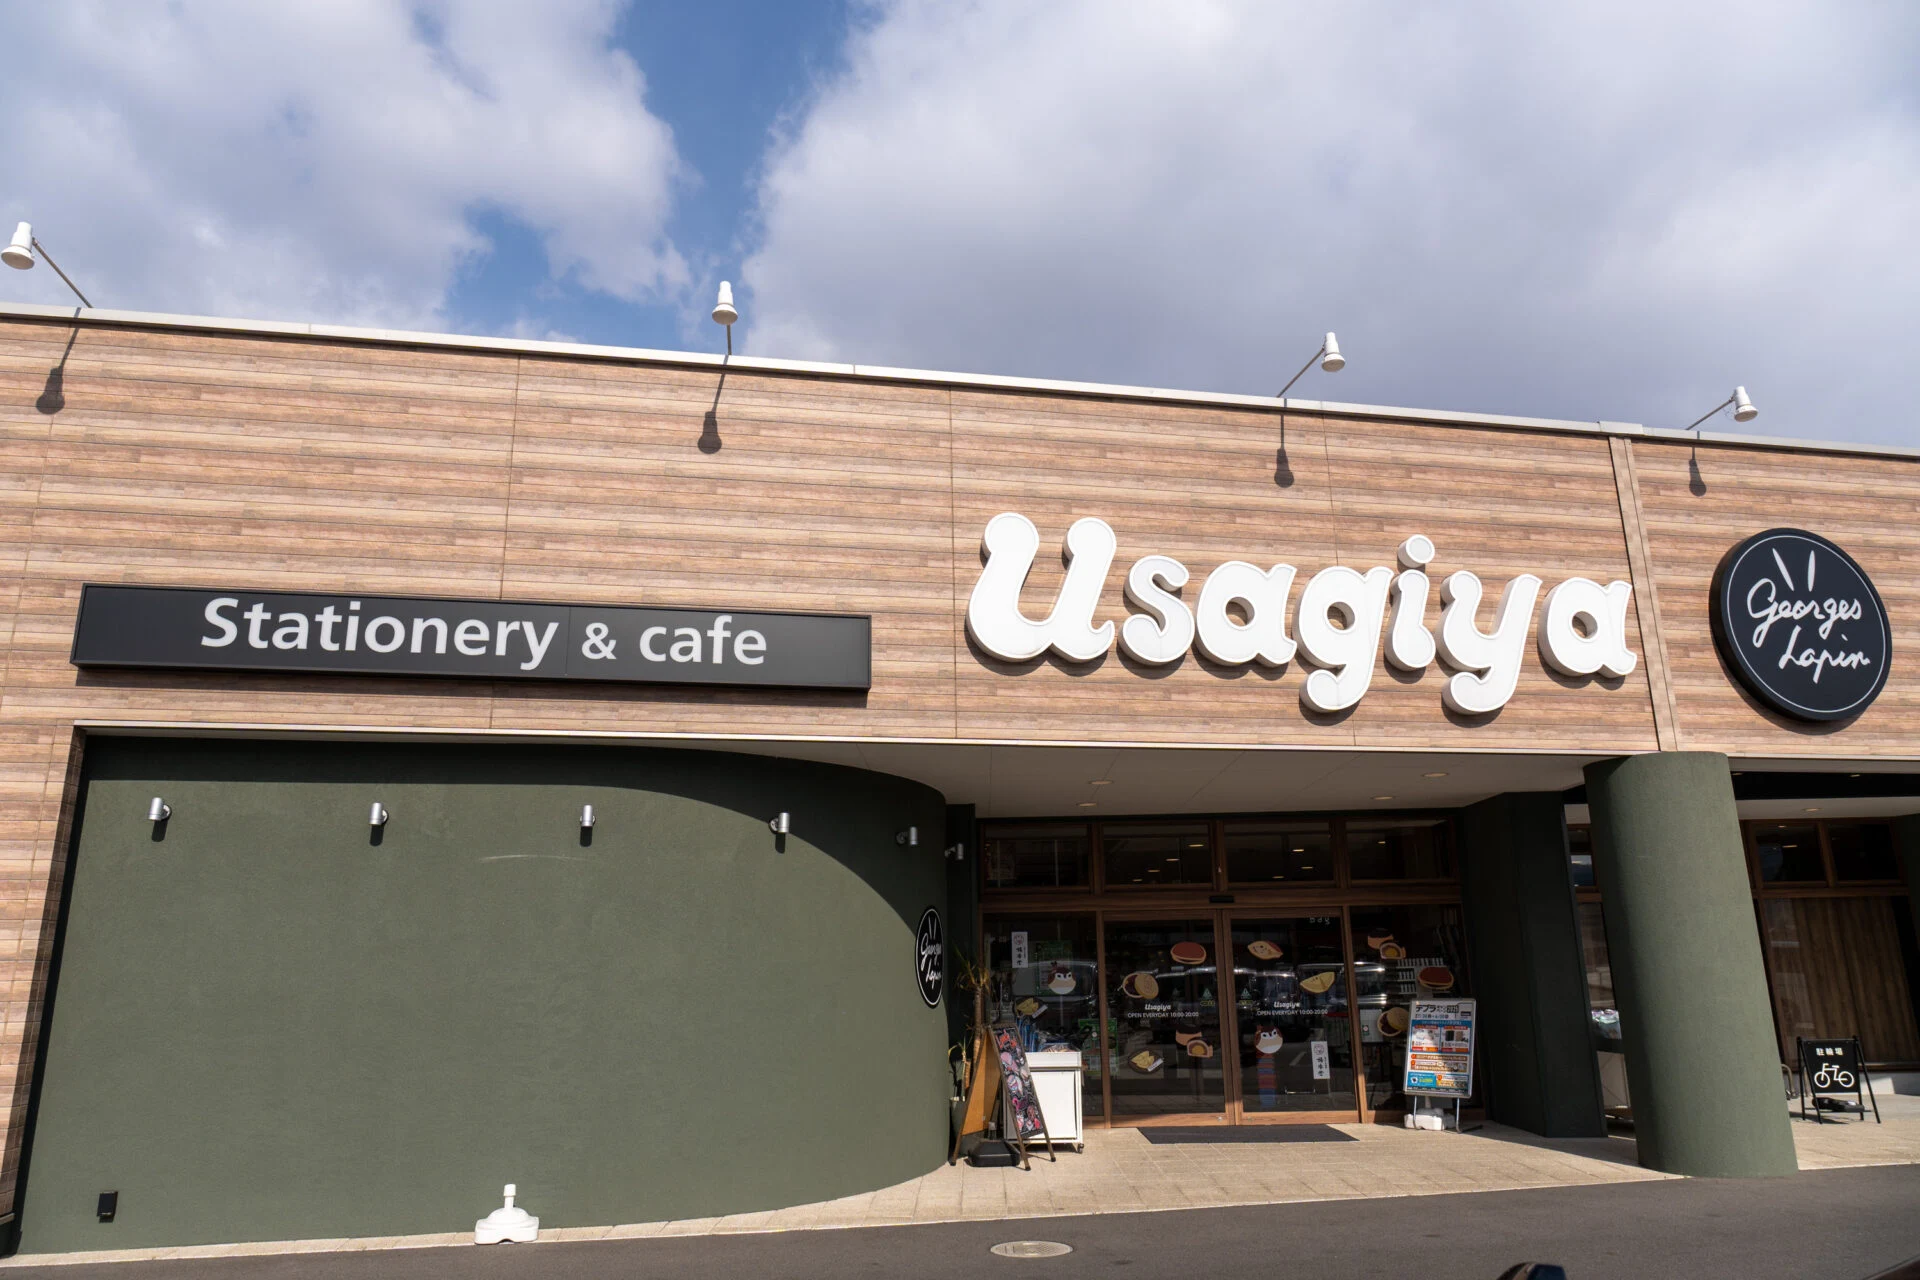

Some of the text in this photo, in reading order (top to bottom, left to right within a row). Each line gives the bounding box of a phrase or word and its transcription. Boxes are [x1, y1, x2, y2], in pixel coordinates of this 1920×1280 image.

[201, 597, 768, 671] Stationery & cafe
[966, 512, 1638, 712] Usagiya
[1747, 577, 1862, 648] Georges
[1778, 624, 1871, 684] Lapin
[1144, 1003, 1172, 1011] Usagiya
[1273, 1001, 1300, 1009] Usagiya
